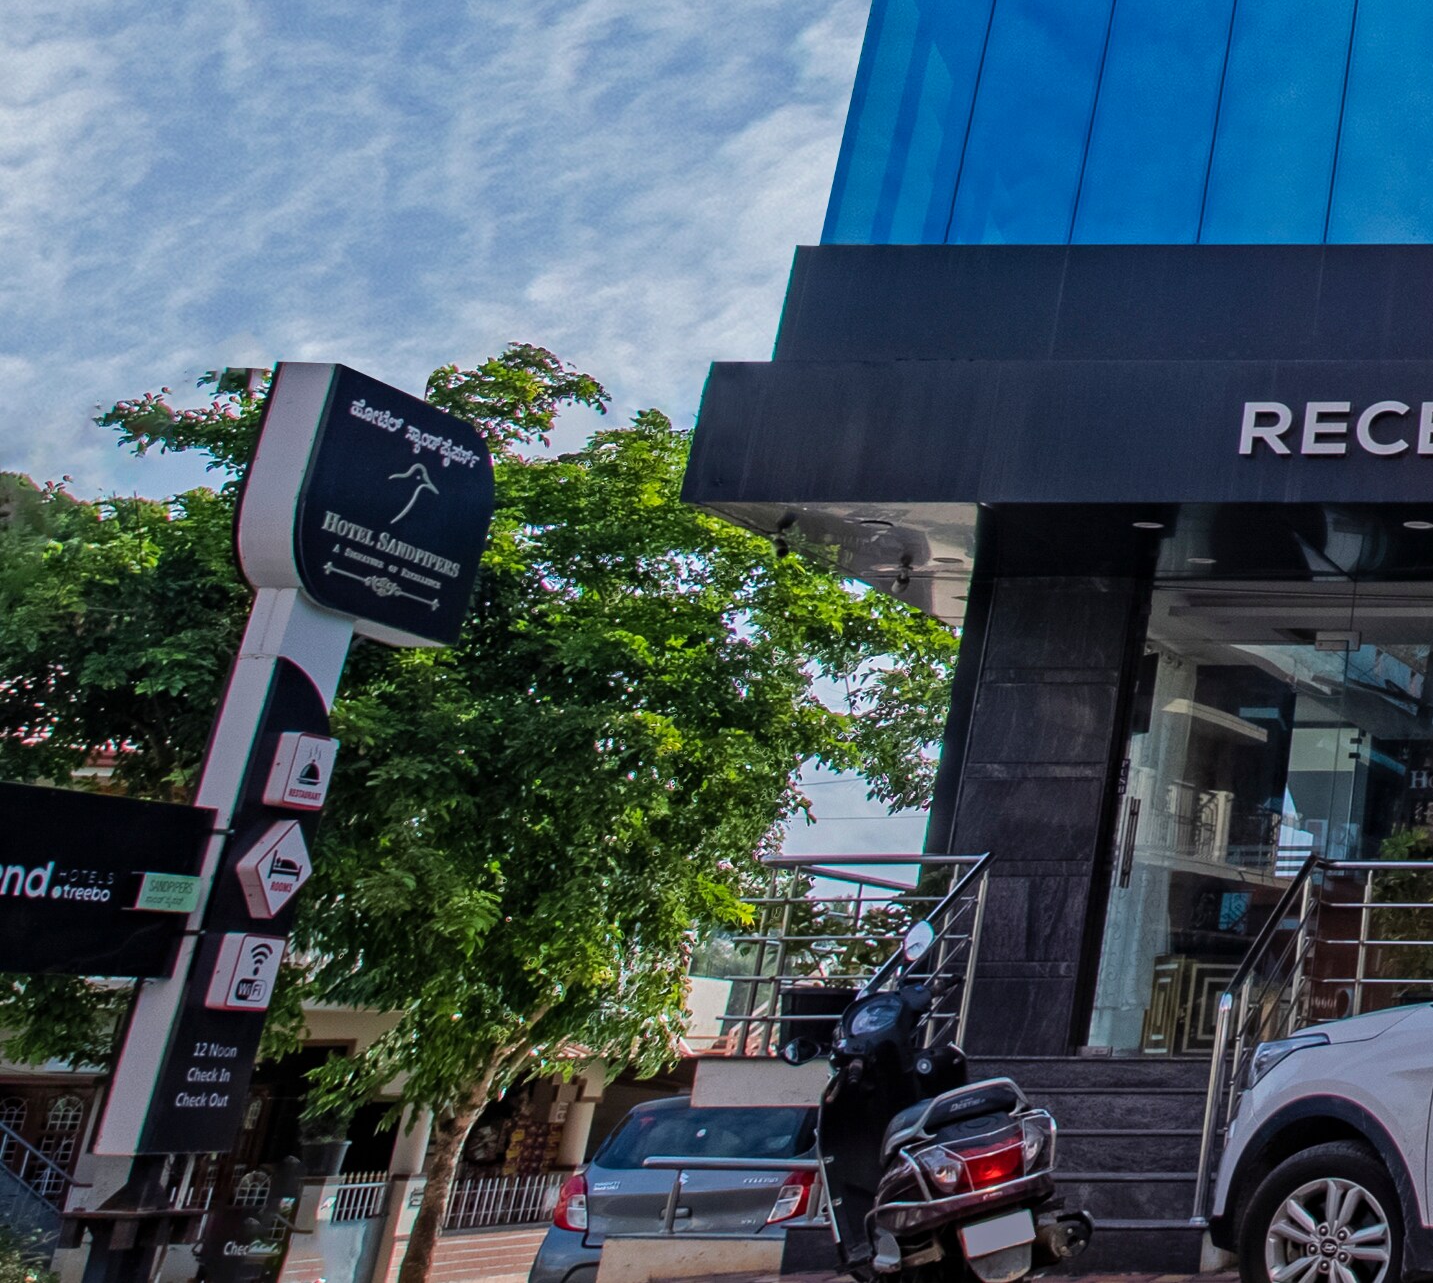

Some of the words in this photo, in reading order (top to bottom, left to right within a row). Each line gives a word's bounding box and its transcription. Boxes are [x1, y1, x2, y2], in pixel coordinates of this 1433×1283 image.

[321, 511, 375, 546] HOTEL
[376, 532, 461, 578] SANDPIPERS
[193, 1042, 206, 1057] 12
[208, 1043, 237, 1058] Noon
[187, 1068, 217, 1082] Check
[217, 1068, 231, 1082] In
[175, 1092, 206, 1107] Check
[208, 1092, 229, 1107] Out
